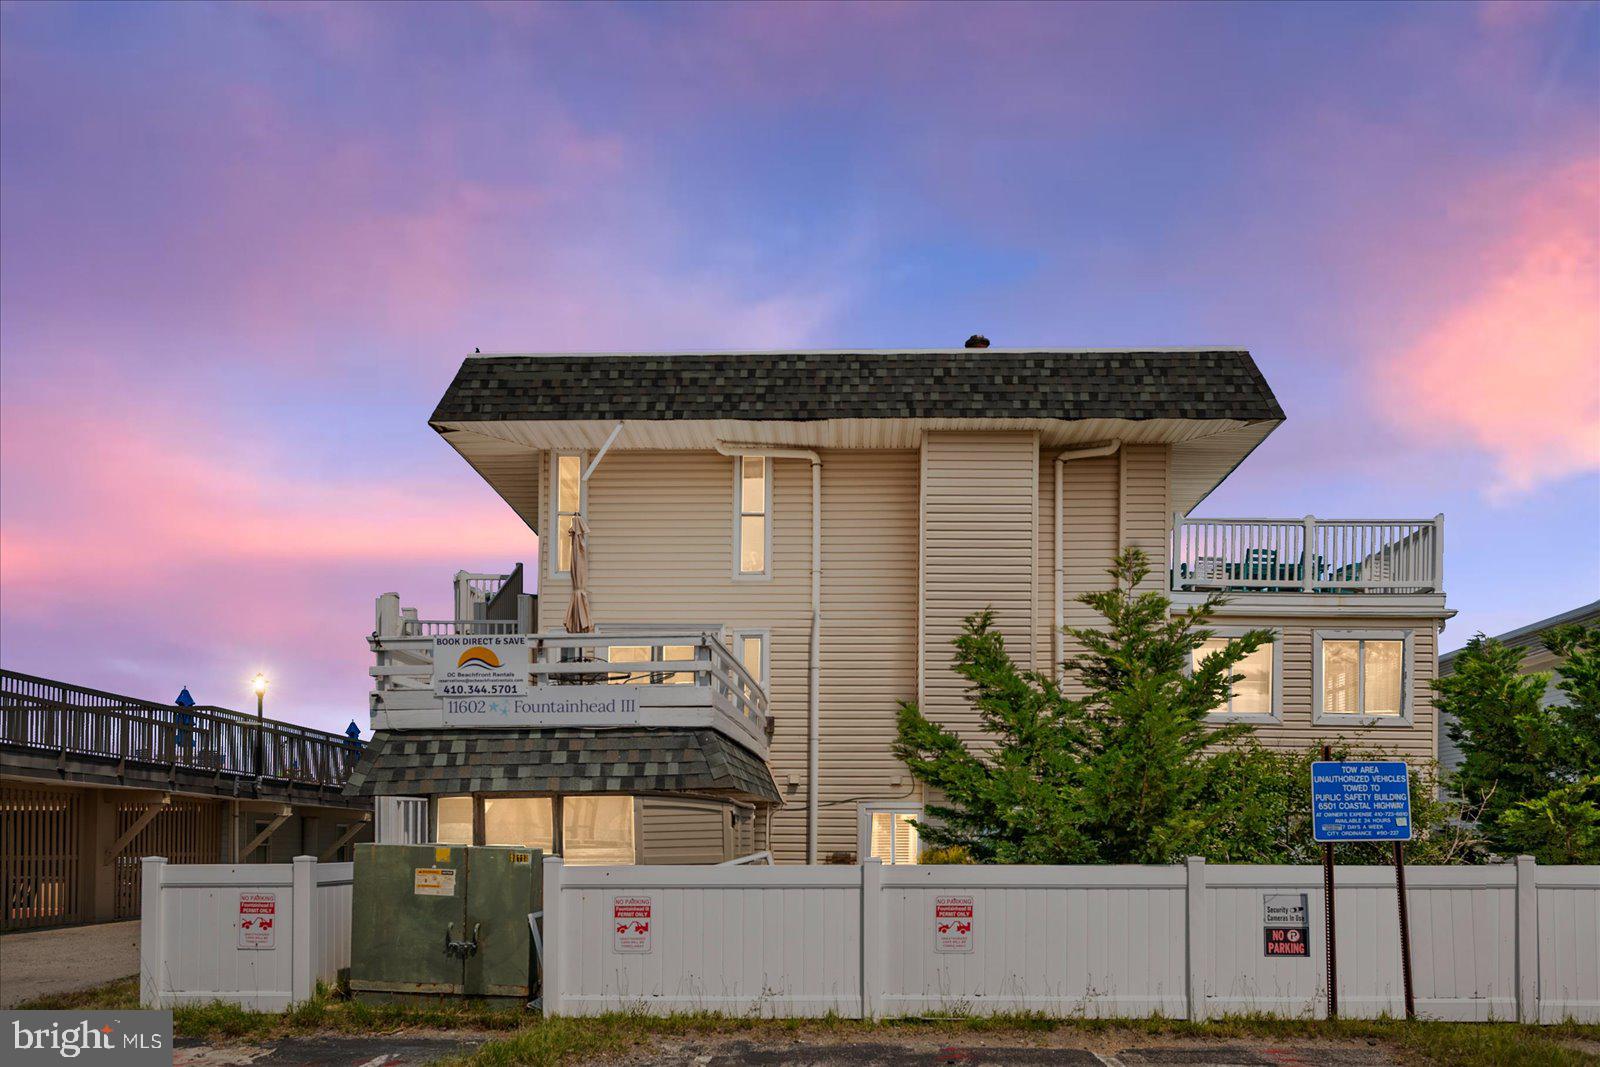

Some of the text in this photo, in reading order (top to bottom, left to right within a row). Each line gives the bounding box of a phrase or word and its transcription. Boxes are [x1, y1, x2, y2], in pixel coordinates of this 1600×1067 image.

[436, 638, 460, 646] BOOK
[462, 638, 493, 646] DIRECT
[444, 685, 518, 694] 410.344.5701
[448, 700, 636, 714] 11602 Fountainhead III
[1272, 930, 1284, 940] NO
[1268, 942, 1304, 954] PARKING
